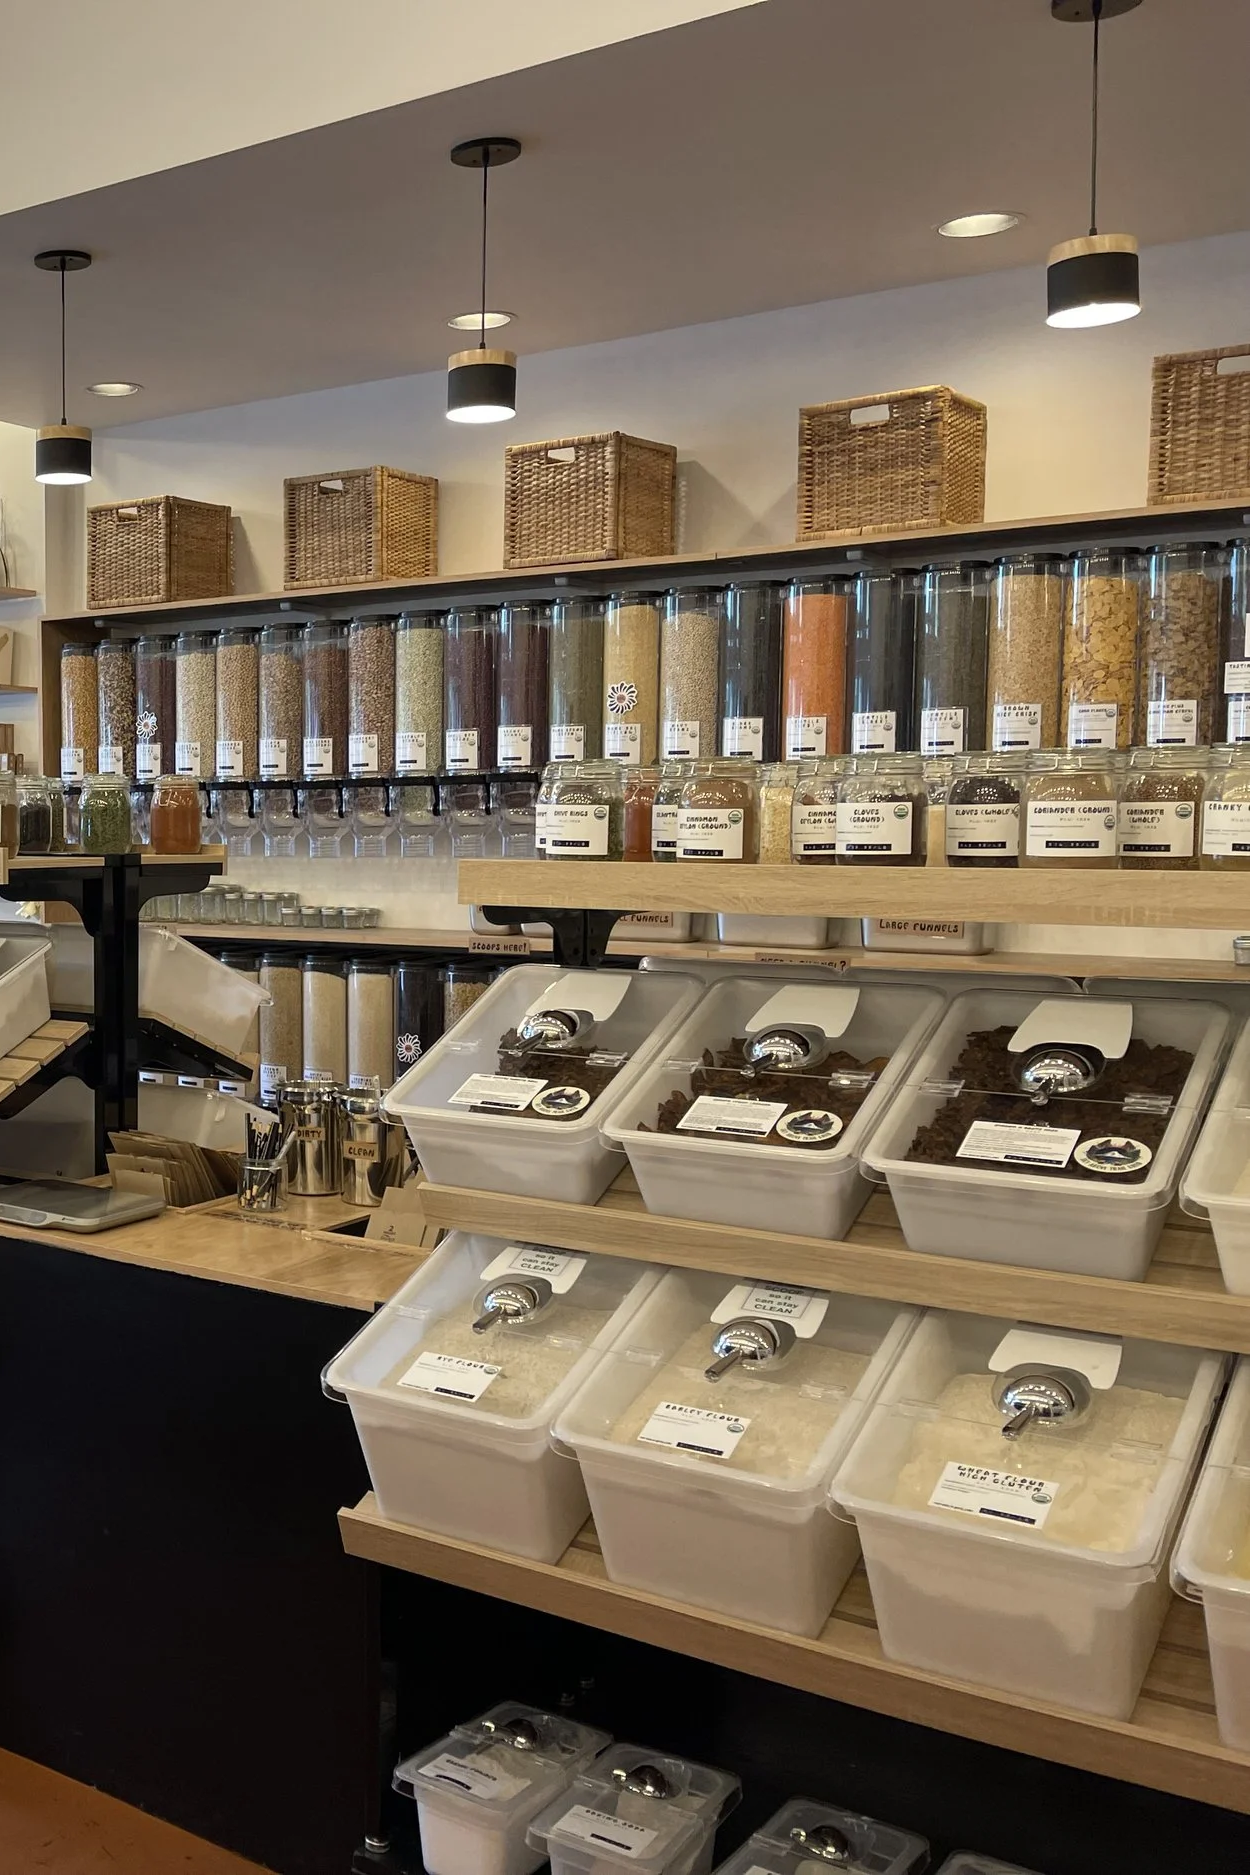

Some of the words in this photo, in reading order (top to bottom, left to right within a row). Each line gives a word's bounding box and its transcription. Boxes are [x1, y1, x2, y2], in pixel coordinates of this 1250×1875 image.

[955, 808, 978, 816] CLOVES
[1034, 806, 1075, 814] CORIANDER
[879, 918, 909, 930] LARGE
[913, 922, 958, 933] FUNNELS
[472, 942, 500, 950] SCOOPS
[503, 942, 527, 952] HERE!
[297, 1130, 322, 1138] DIRTY
[348, 1146, 375, 1157] CLEAN
[521, 1263, 554, 1272] CLEAN
[754, 1303, 793, 1314] CLEAN
[777, 1301, 799, 1309] stay
[456, 1360, 484, 1369] FLOUR
[665, 1404, 702, 1416] BARLEY
[706, 1412, 740, 1423] FLOUR
[957, 1465, 999, 1478] WHEAT
[1005, 1475, 1045, 1488] FLOUR
[959, 1471, 987, 1481] HIGH
[992, 1478, 1042, 1493] GLUTEN
